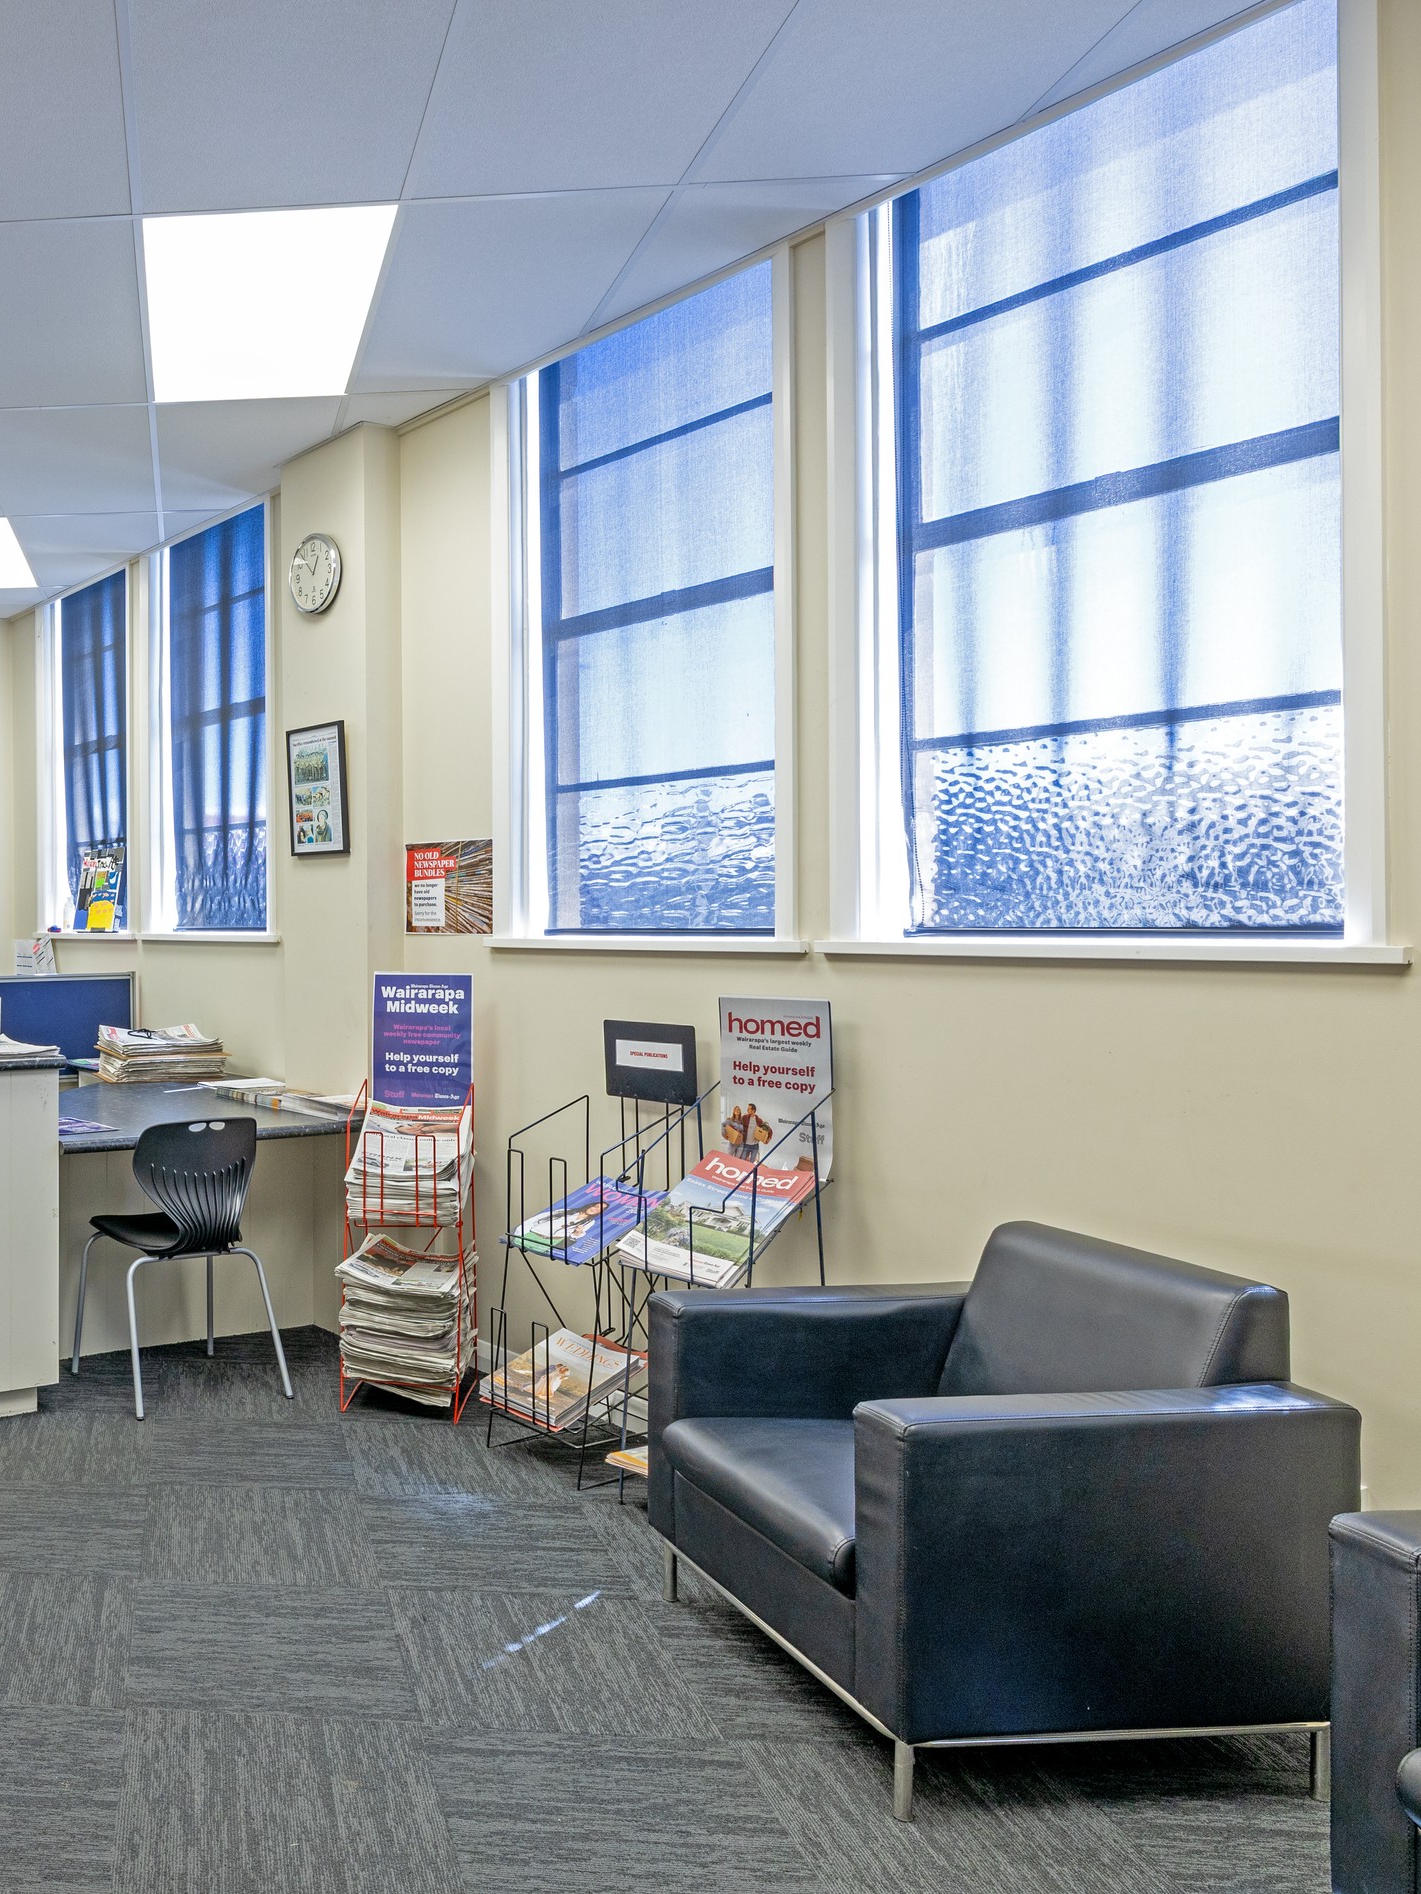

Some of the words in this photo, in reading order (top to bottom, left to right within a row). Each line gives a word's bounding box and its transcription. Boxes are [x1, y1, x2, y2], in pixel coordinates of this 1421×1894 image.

[325, 550, 329, 560] 2
[328, 563, 332, 573] 3
[296, 574, 300, 584] 9
[298, 587, 302, 596] 8
[304, 594, 308, 604] 7
[312, 595, 316, 605] 6
[414, 852, 424, 860] NO
[425, 851, 439, 859] OLD
[414, 859, 454, 869] NEWSPAPER
[414, 869, 445, 877] BUNDLES
[381, 986, 465, 1002] Wairarapa
[387, 1000, 458, 1014] Midweek
[728, 1011, 820, 1039] homed
[737, 1036, 769, 1044] Wairarapa's
[386, 1052, 410, 1063] Help
[413, 1053, 459, 1063] yourself
[385, 1064, 396, 1072] to
[407, 1064, 430, 1073] free
[432, 1065, 459, 1076] copy
[733, 1061, 760, 1074] Help
[763, 1065, 816, 1077] yourself
[733, 1075, 745, 1085] to
[748, 1078, 754, 1086] a
[757, 1076, 782, 1088] free
[785, 1081, 816, 1094] copy
[799, 1132, 825, 1144] Stff
[556, 1337, 622, 1367] WEDDNGS
